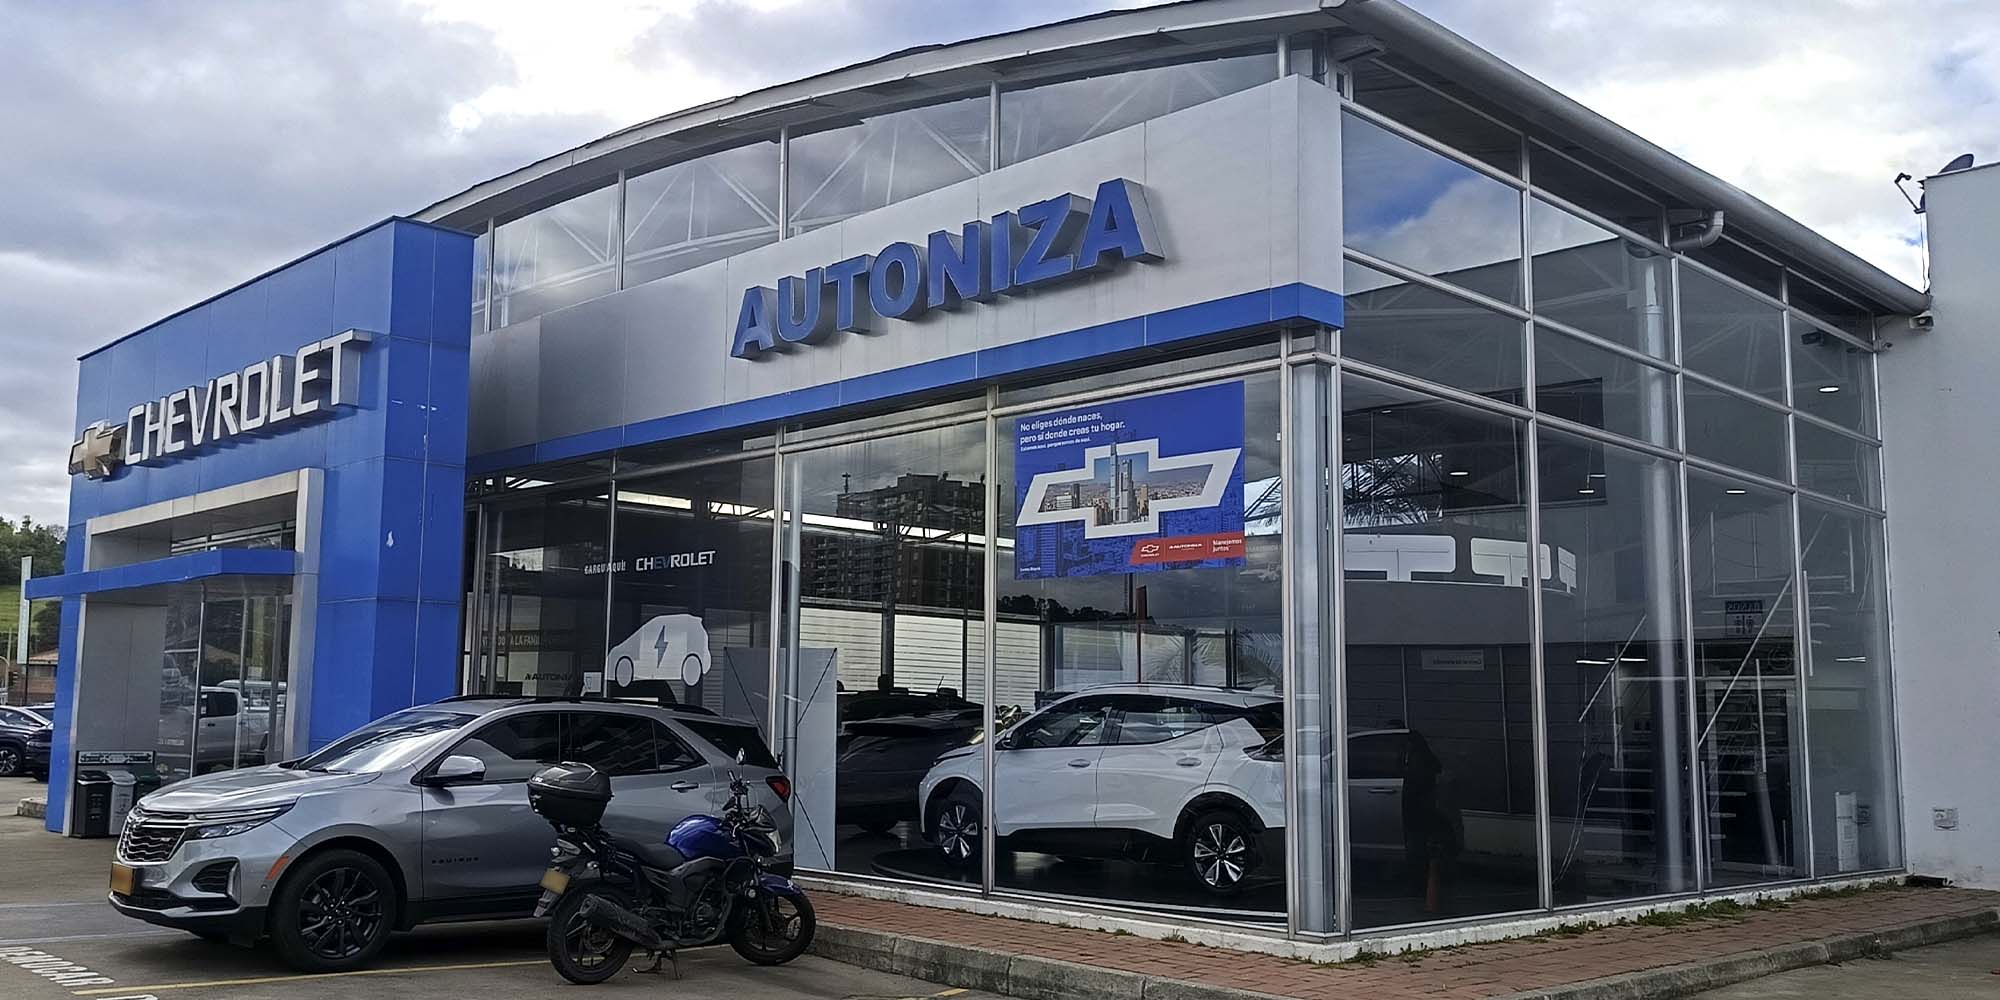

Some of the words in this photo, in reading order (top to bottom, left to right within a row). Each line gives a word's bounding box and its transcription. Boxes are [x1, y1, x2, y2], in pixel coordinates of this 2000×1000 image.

[730, 177, 1160, 360] AUTONIZA
[124, 328, 368, 467] CHEVROLET
[1020, 423, 1031, 432] No
[1031, 420, 1053, 431] eliges
[1077, 412, 1103, 422] naces,
[1020, 435, 1037, 445] pero
[1068, 426, 1090, 436] creas
[1091, 424, 1099, 432] tu
[1100, 421, 1126, 432] hogar.
[635, 550, 716, 571] CHEVROLET
